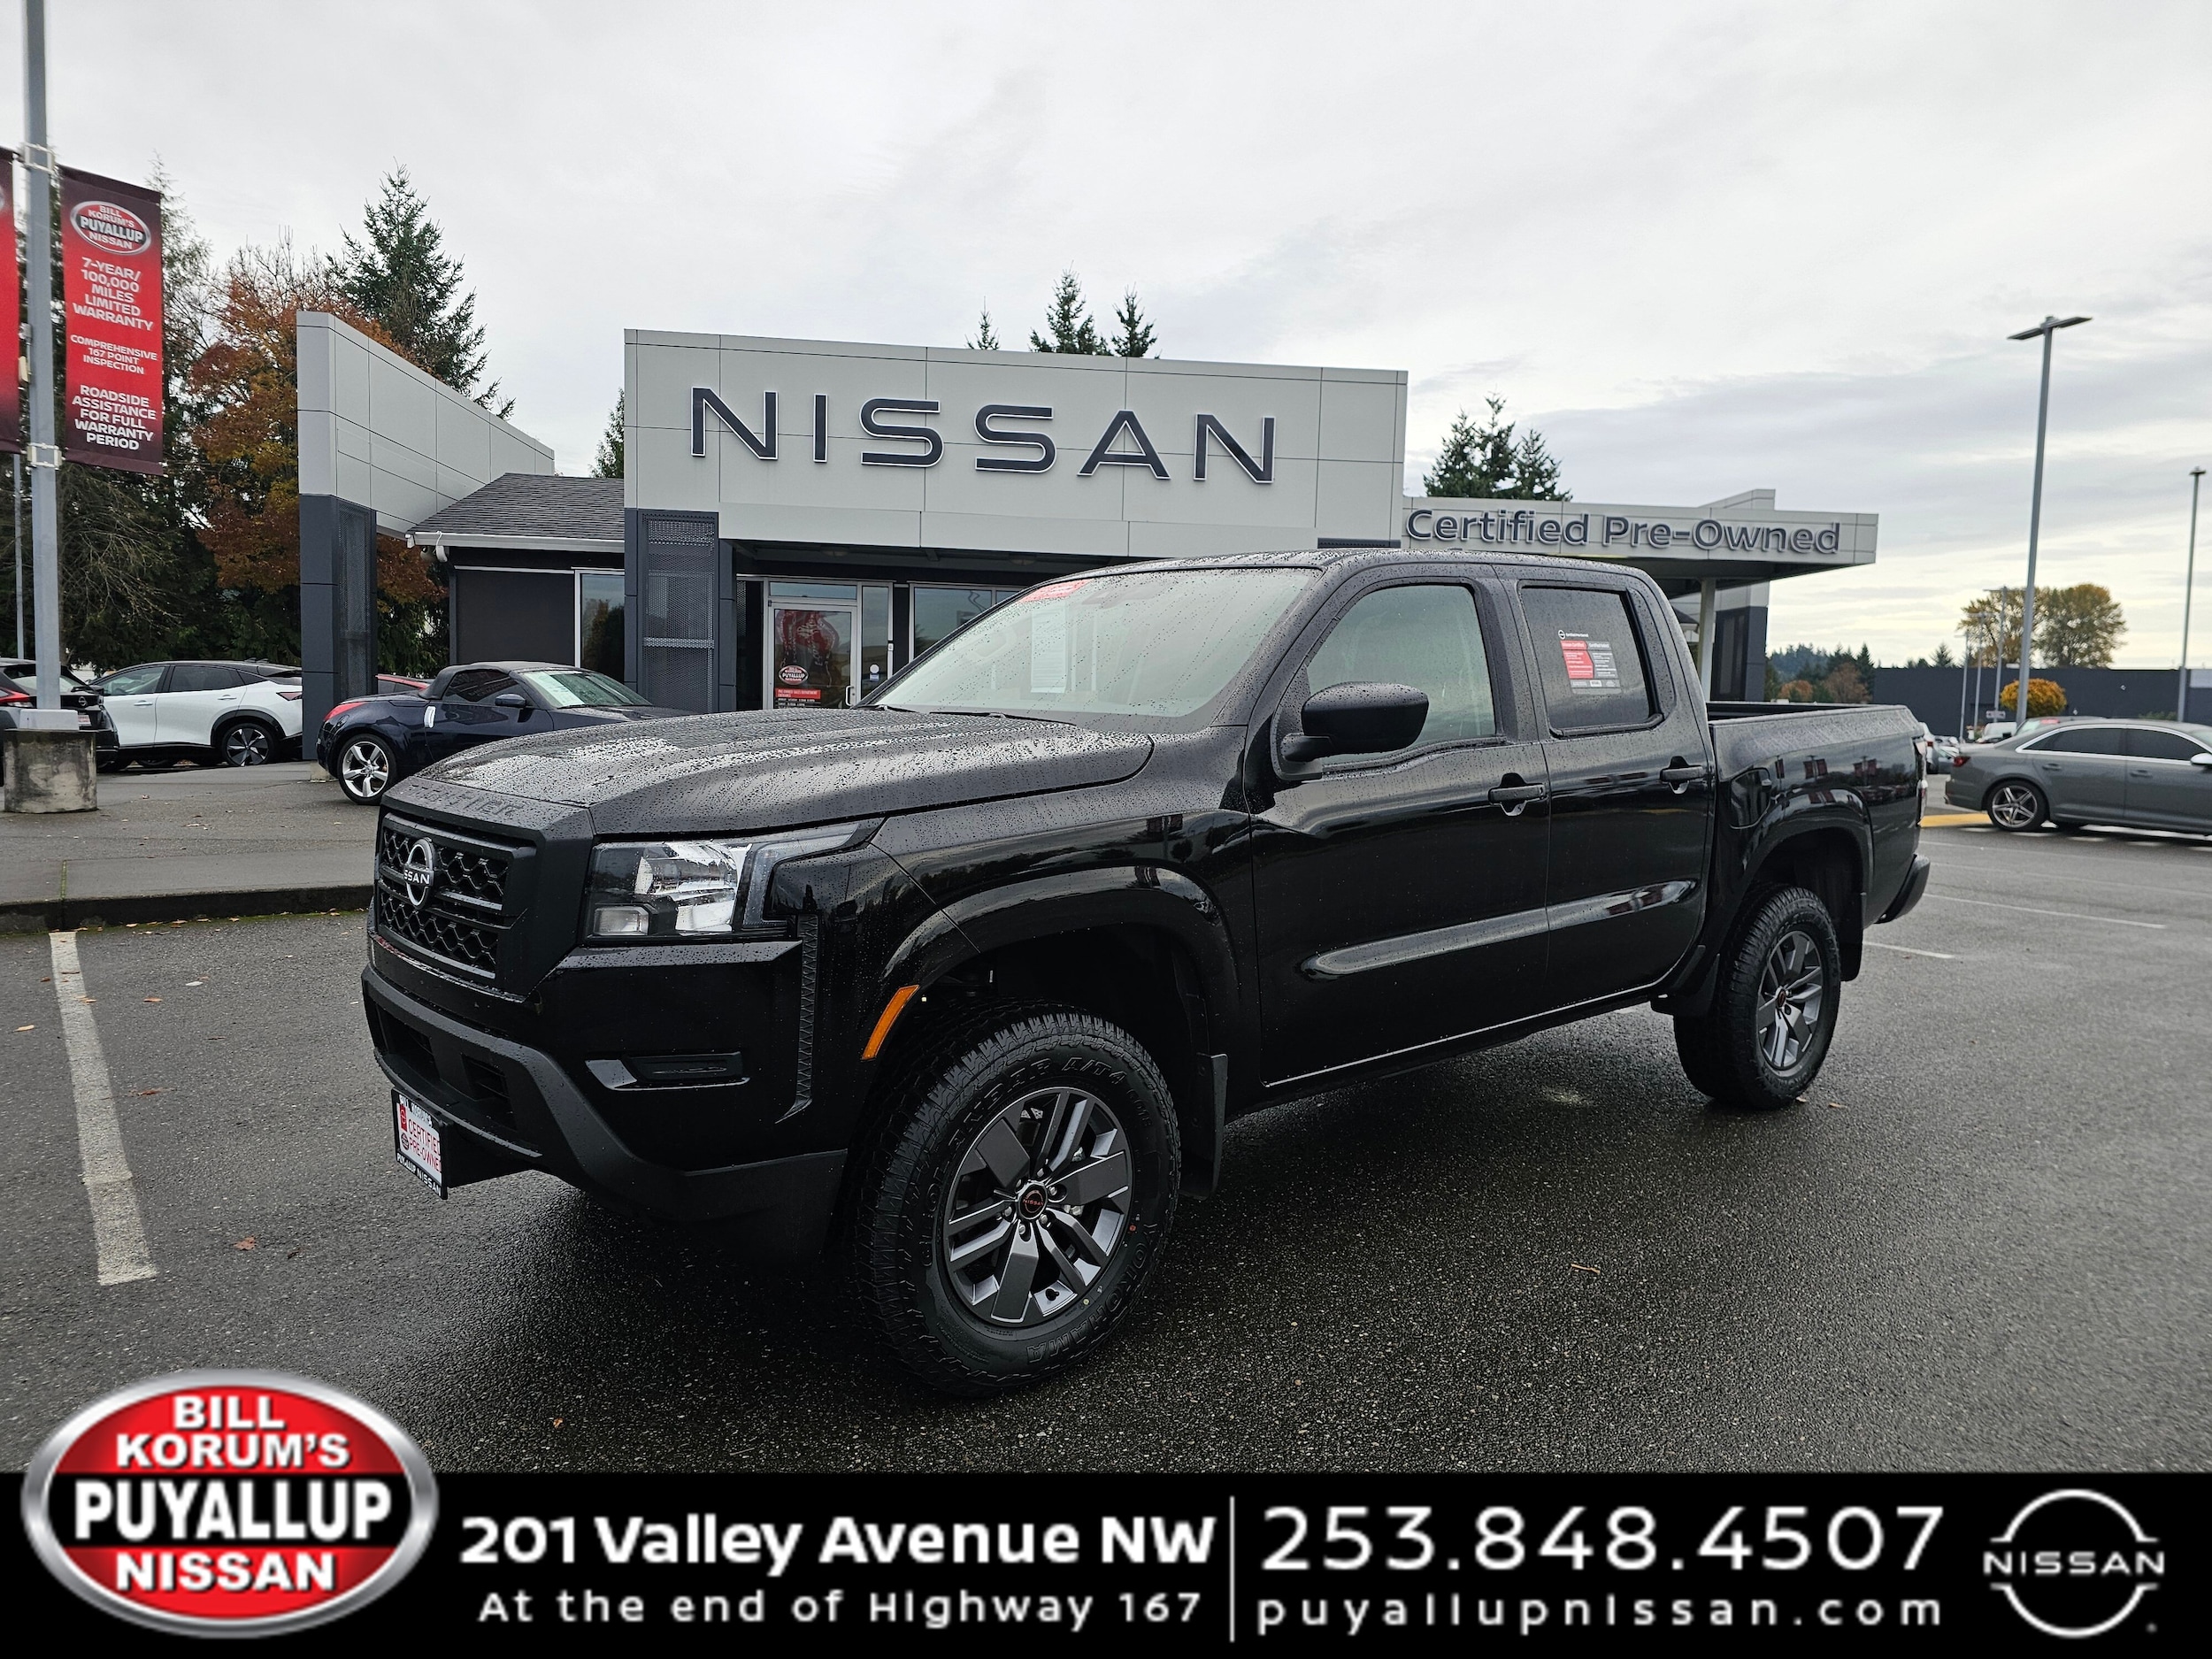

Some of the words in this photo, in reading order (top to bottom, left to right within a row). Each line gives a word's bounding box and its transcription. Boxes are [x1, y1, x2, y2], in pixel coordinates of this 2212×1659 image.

[88, 210, 135, 227] KORUM'S
[99, 204, 122, 219] BILL
[80, 216, 143, 242] PUYALLUP
[88, 232, 133, 250] NISSAN
[81, 257, 141, 281] 7-YEAR/
[81, 269, 140, 292] 100,000
[91, 283, 134, 303] MILES
[73, 302, 153, 331] WARRANTY
[84, 294, 141, 316] LIMITED
[70, 334, 157, 360] COMPREHENSIVE
[88, 348, 106, 358] 167
[107, 351, 139, 365] POINT
[83, 354, 144, 374] INSPECTION
[80, 384, 150, 407] ROADSIDE
[72, 396, 156, 419] ASSISTANCE
[80, 408, 110, 423] FOR
[111, 414, 146, 429] FULL
[74, 419, 154, 442] WARRANTY
[86, 432, 140, 450] PERIOD
[690, 385, 1276, 485] NISSAN
[1407, 509, 1589, 546] Certified
[1602, 515, 1840, 554] Pre-Owned
[417, 1168, 442, 1197] NISSAN
